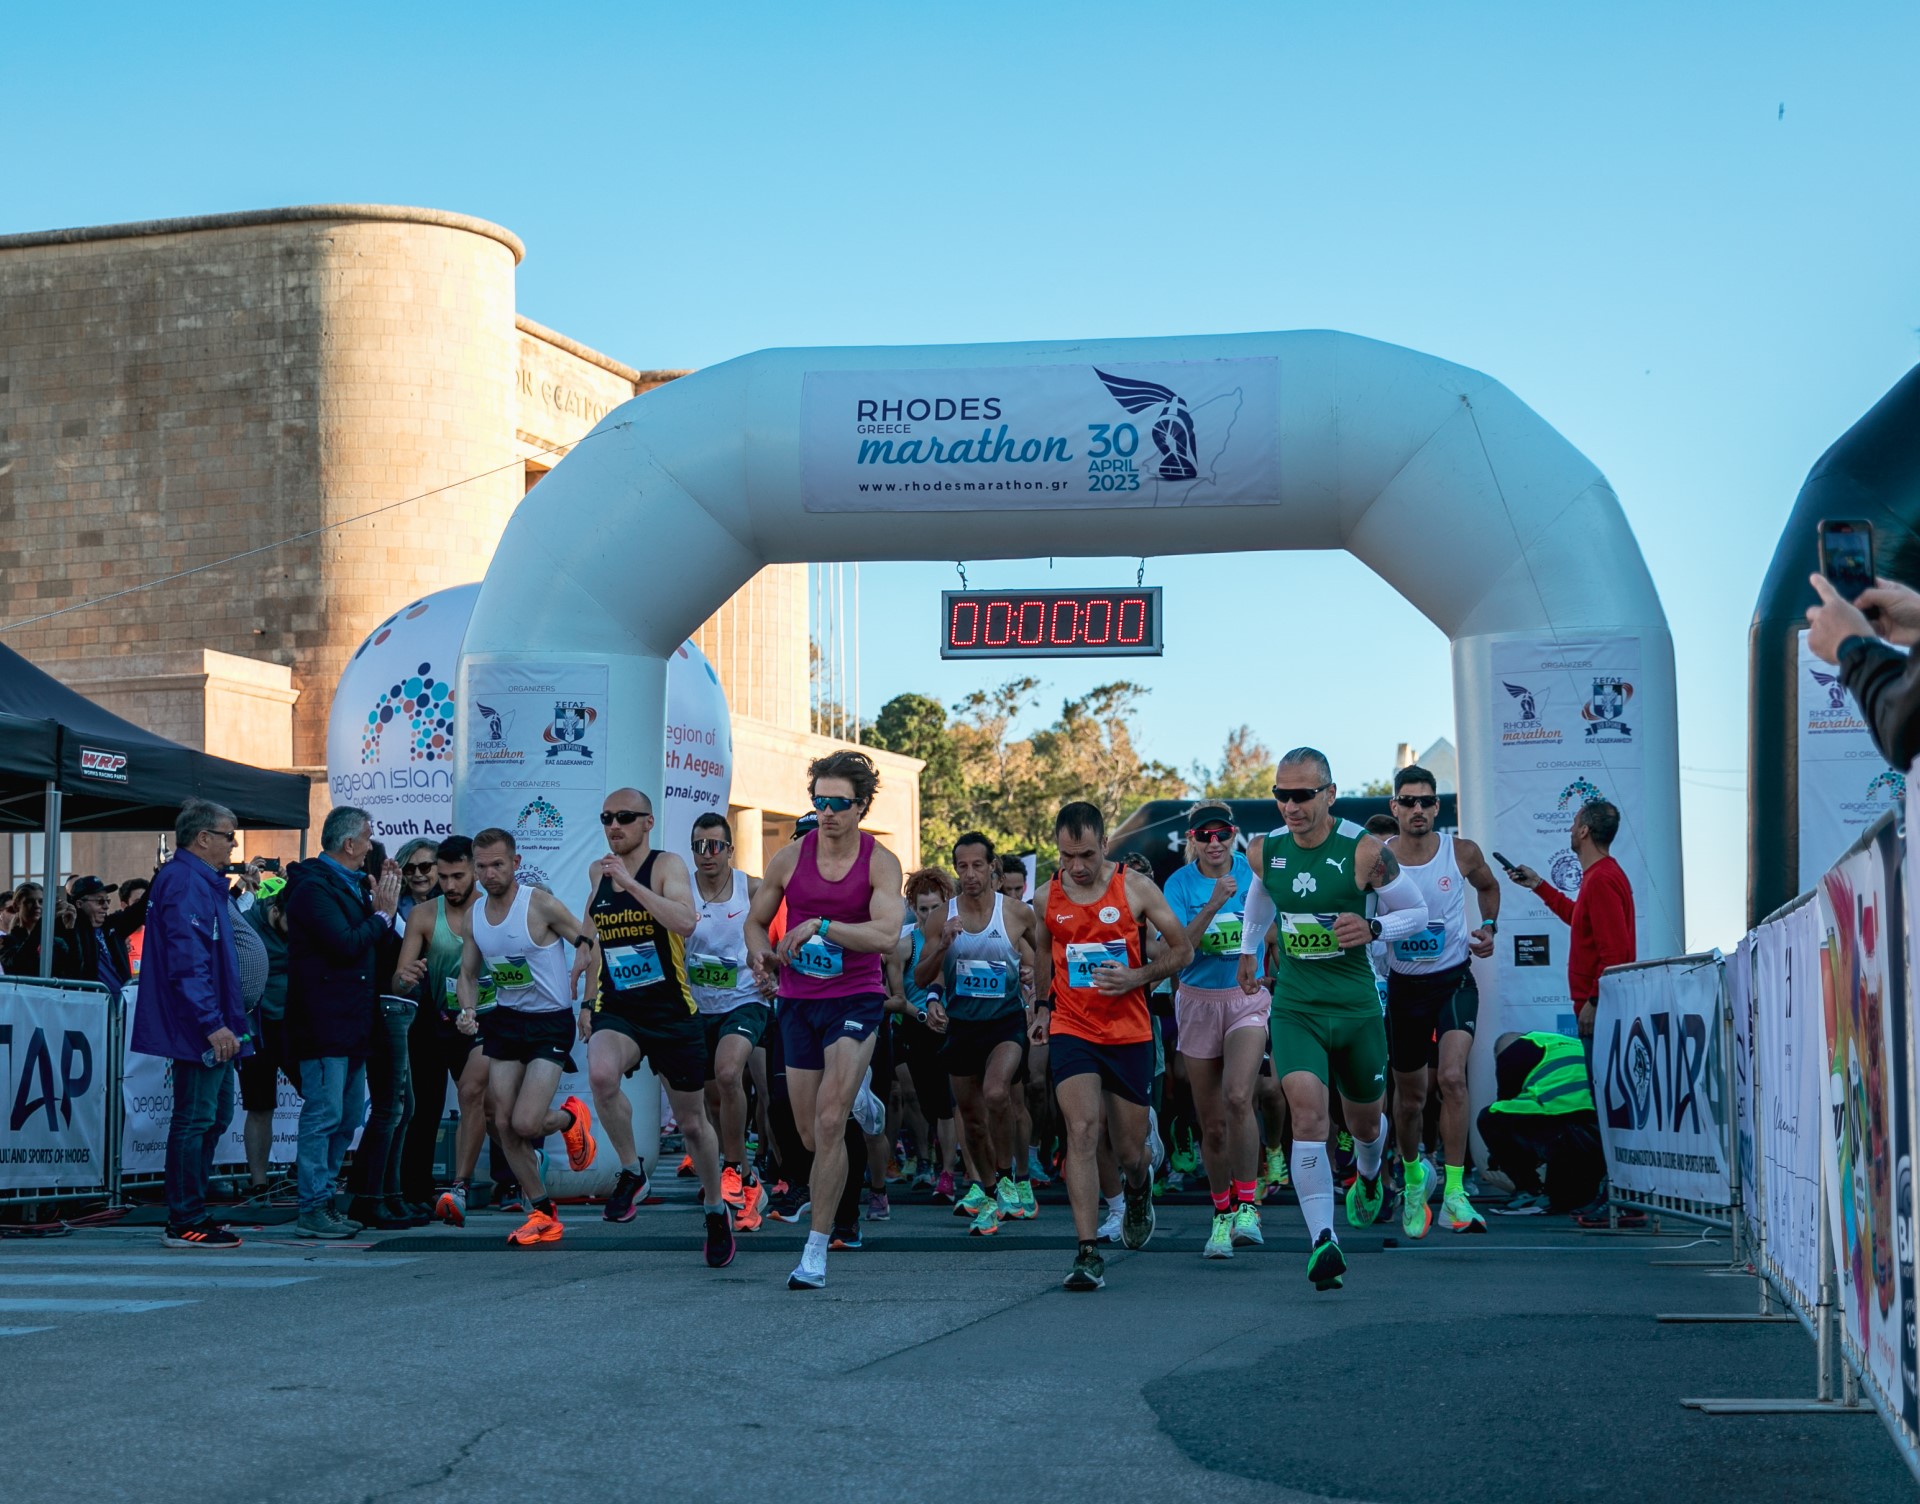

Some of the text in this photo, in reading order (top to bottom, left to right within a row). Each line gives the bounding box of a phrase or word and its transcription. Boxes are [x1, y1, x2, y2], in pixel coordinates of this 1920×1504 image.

[857, 397, 1002, 422] RHODES
[857, 424, 912, 434] GREECE
[857, 424, 1074, 465] marathon
[1087, 422, 1139, 458] 30
[1088, 459, 1139, 473] APRIL
[858, 479, 1068, 492] www.rhodesmarathon.gr
[1088, 473, 1141, 492] 2023
[951, 600, 1145, 645] 00:00:00
[1540, 660, 1593, 669] ORGANIZERS
[1592, 677, 1623, 685] ΣΕΓΑΣ
[507, 685, 556, 693] ORGANIZERS
[555, 701, 586, 709] ΣΕΓΑΣ
[1809, 710, 1851, 718] RHODES
[1503, 720, 1542, 730] RHODES
[705, 728, 716, 746] of
[1502, 727, 1563, 741] marathon
[476, 741, 507, 749] RHODES
[474, 747, 525, 759] marathon
[82, 750, 127, 772] WRP
[683, 753, 724, 778] Aegean
[1550, 759, 1602, 769] ORGANIZERS
[113, 773, 127, 781] PARTS
[331, 771, 387, 800] aegean
[1533, 813, 1571, 823] aegean
[377, 819, 419, 836] South
[530, 829, 564, 837] islands
[593, 908, 654, 928] Chorlton
[599, 924, 655, 942] Runners
[1210, 930, 1243, 946] 214
[1288, 933, 1332, 948] 2023
[1400, 938, 1439, 952] 4003
[795, 951, 833, 969] 4143
[493, 969, 524, 982] 2346
[613, 962, 652, 979] 4004
[696, 968, 730, 982] 2134
[963, 976, 999, 989] 4210
[1532, 995, 1560, 1003] UNDER
[28, 1148, 54, 1164] SPORTS
[54, 1148, 64, 1164] OF
